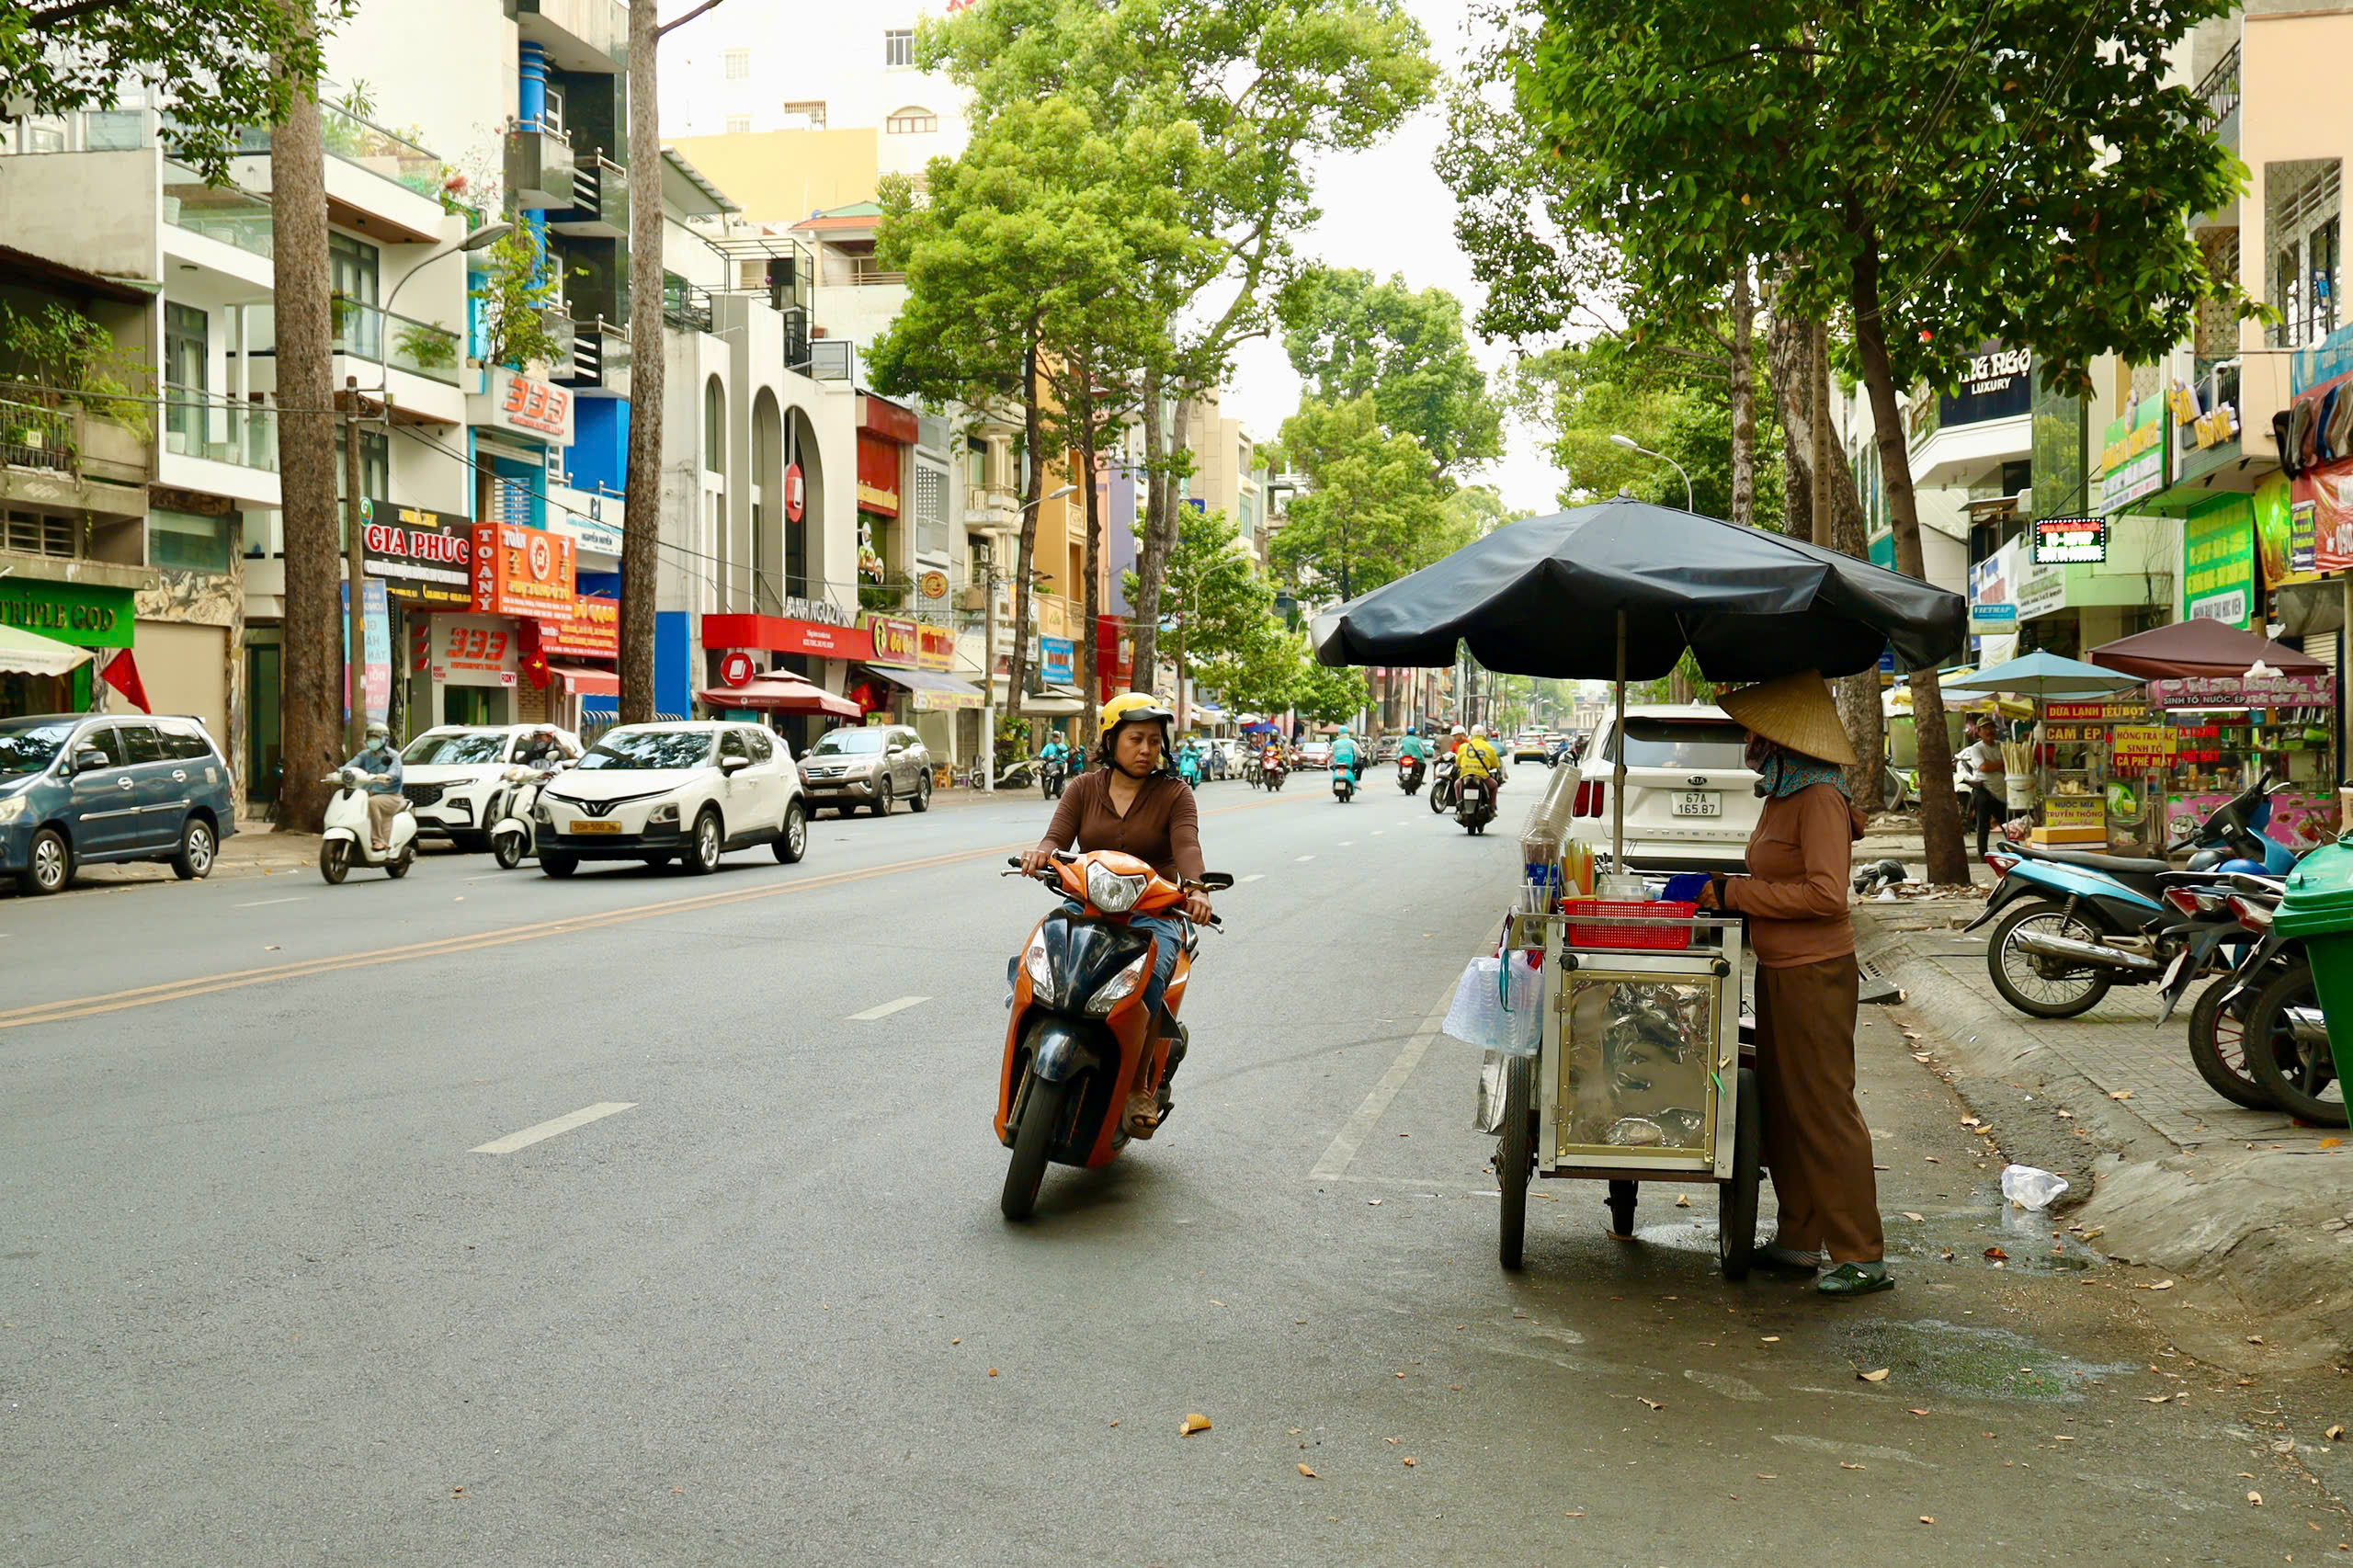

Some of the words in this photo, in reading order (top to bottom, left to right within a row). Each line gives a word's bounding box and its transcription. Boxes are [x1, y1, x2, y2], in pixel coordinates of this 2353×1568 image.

[1972, 377, 2012, 395] LUXURY
[503, 377, 568, 425] 333
[364, 524, 408, 556] GIA
[410, 526, 470, 564] PHÚC
[785, 596, 809, 619] ANH
[71, 604, 115, 632] GOD
[447, 627, 508, 662] 333
[2164, 694, 2186, 705] SINH
[2187, 693, 2200, 704] TỐ
[2203, 692, 2232, 703] NƯỚC
[2234, 692, 2245, 704] ÉP
[2073, 706, 2099, 720] LẠNH
[2047, 728, 2076, 740] CAM
[2084, 725, 2101, 740] ÉP
[2117, 729, 2142, 741] HỒNG
[2143, 730, 2158, 741] TRÀ
[2127, 744, 2149, 754] SINH
[2152, 743, 2163, 754] TỐ
[2117, 755, 2130, 767] CÀ
[2131, 754, 2150, 767] PHÊ
[1690, 777, 1706, 785] KIA
[1686, 793, 1707, 804] 67A
[2055, 799, 2077, 809] NƯỚC
[1679, 803, 1715, 814] 165.87
[2076, 808, 2104, 818] THỐNG
[1646, 829, 1746, 838] SORENTO
